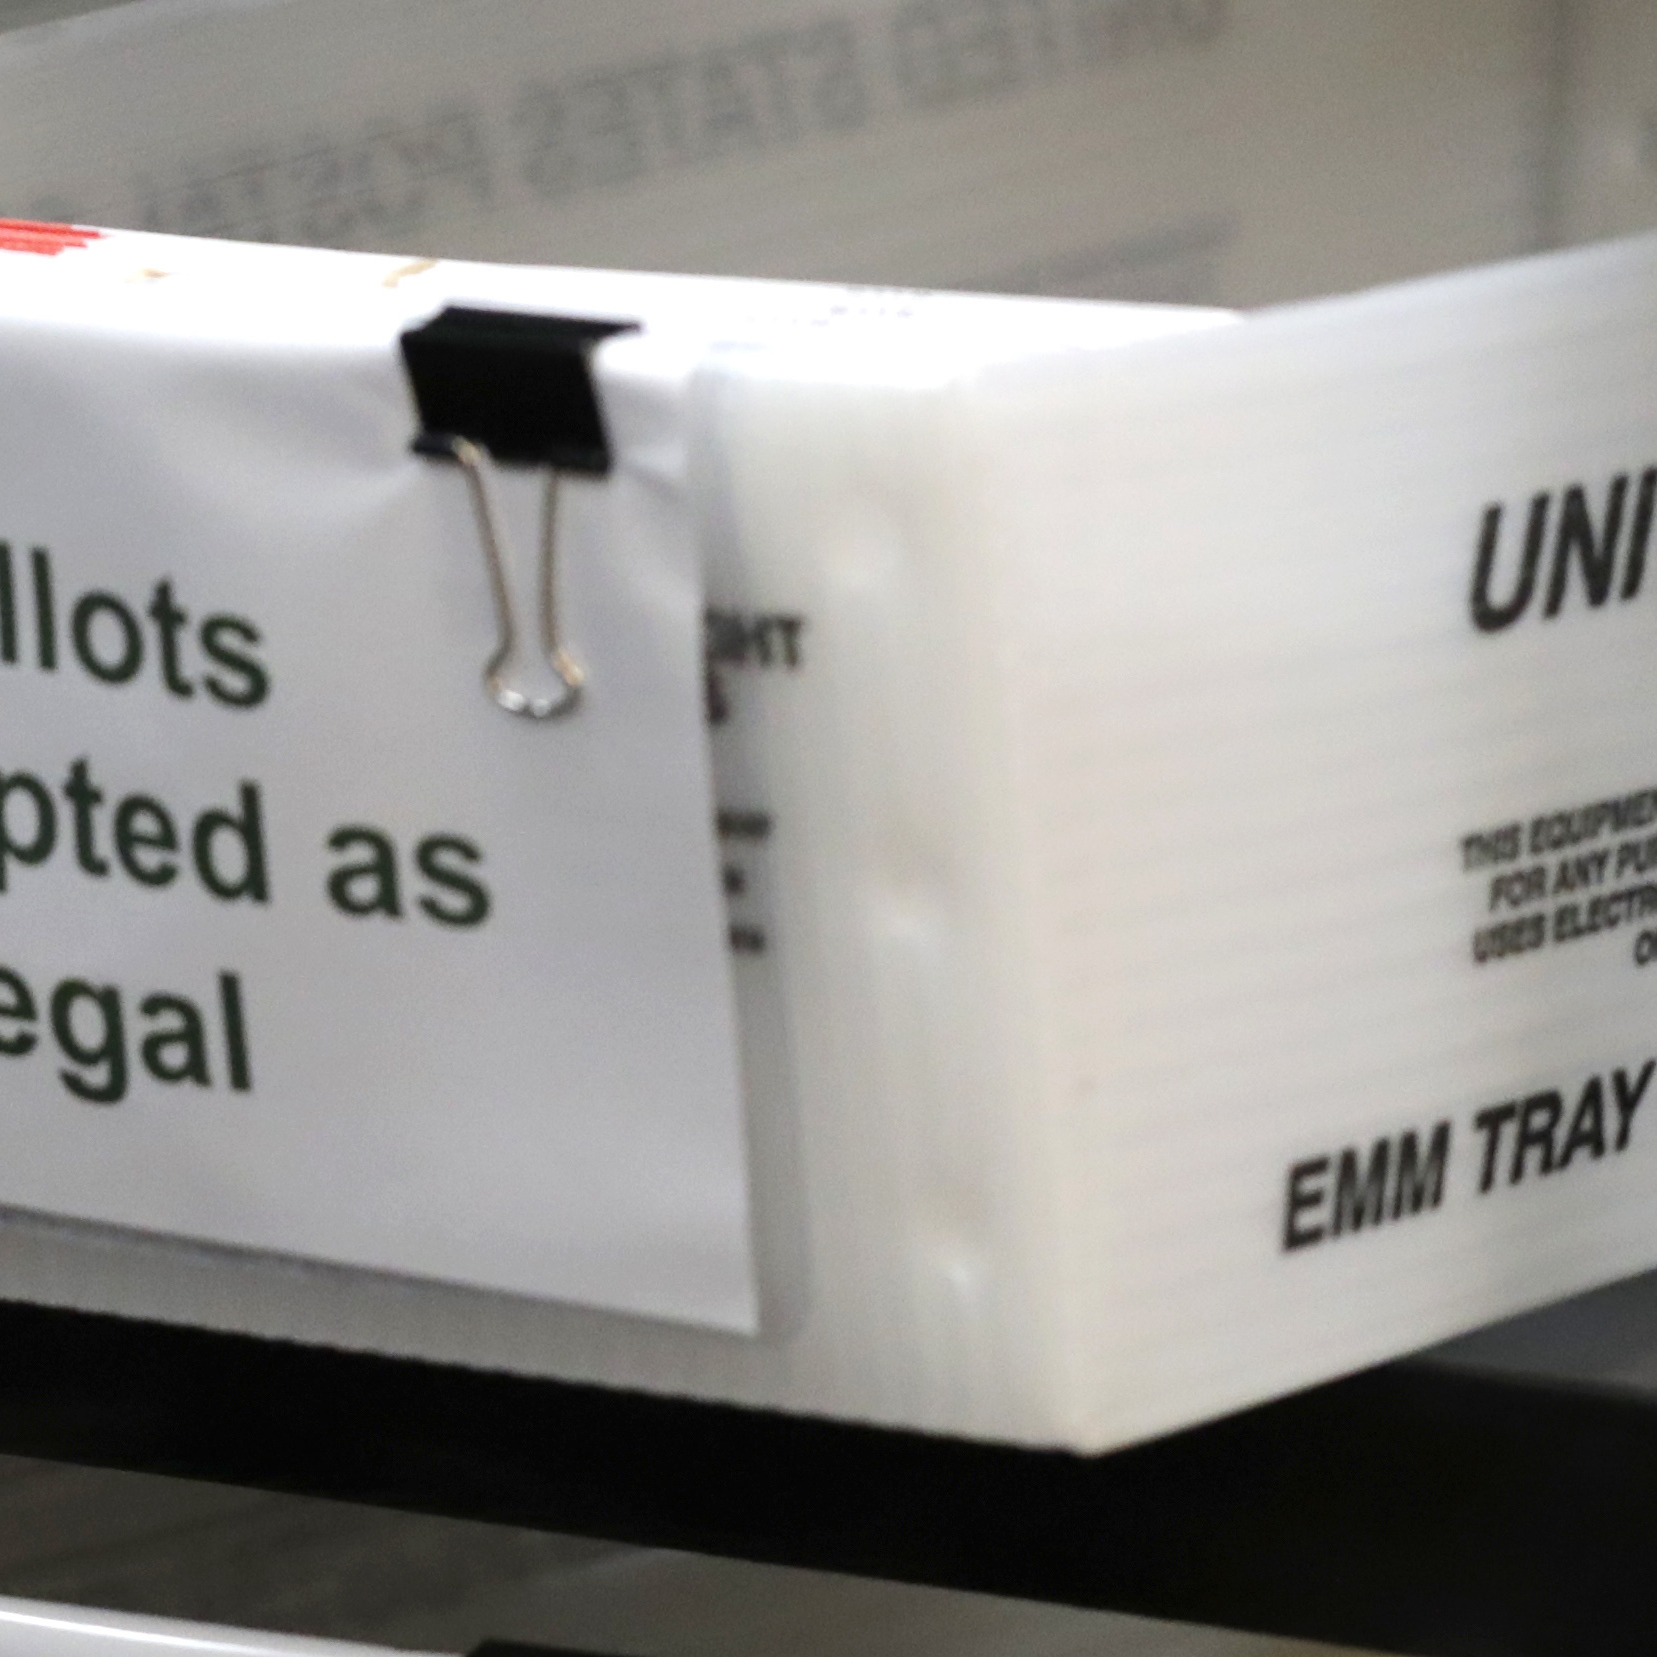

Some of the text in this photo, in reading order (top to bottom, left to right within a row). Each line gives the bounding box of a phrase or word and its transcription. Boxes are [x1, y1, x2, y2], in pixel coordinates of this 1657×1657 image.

[1469, 464, 1657, 636] UNI
[325, 825, 492, 930] as
[1281, 1059, 1657, 1256] EMM TRAY
